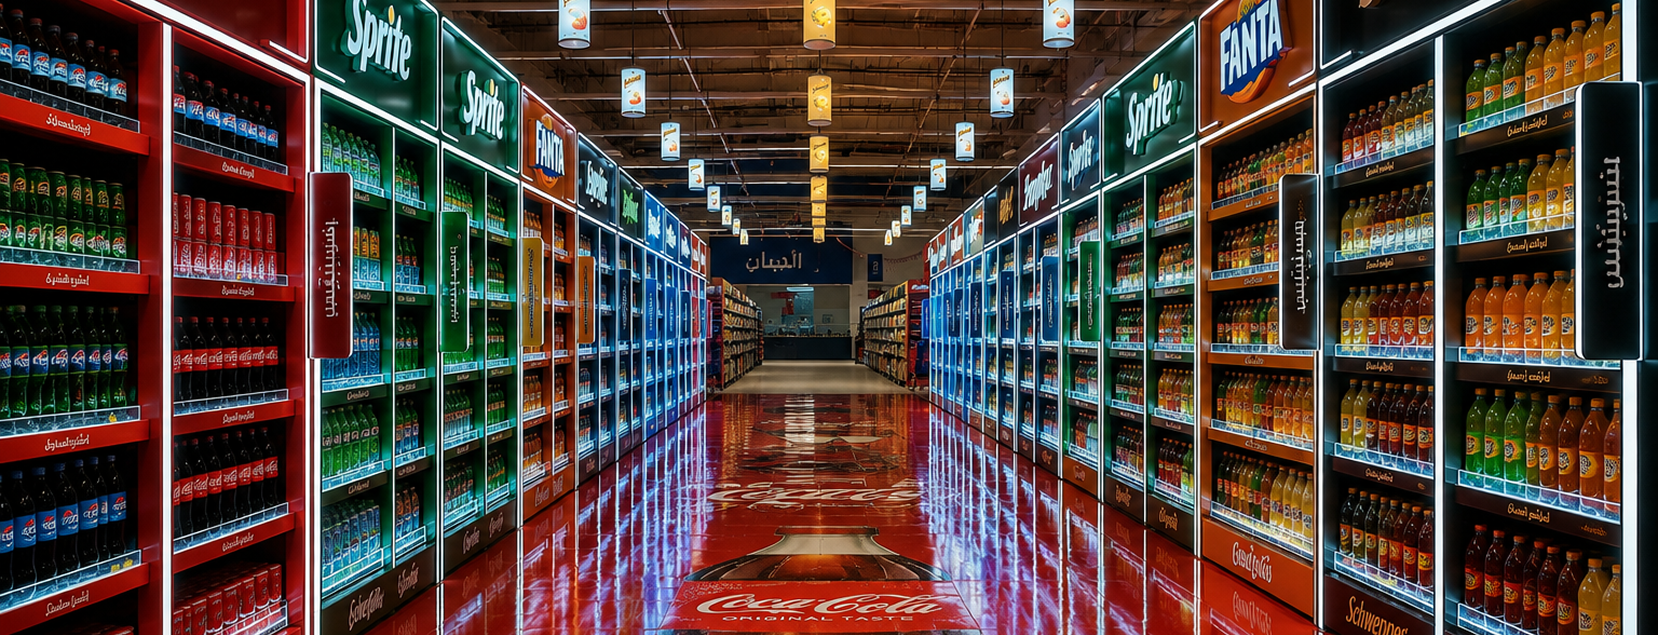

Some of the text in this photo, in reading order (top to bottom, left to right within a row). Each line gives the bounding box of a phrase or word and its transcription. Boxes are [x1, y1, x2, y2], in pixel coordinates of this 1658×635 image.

[347, 0, 412, 81] Sprite
[1220, 0, 1283, 93] FANTA
[463, 69, 505, 140] Sprite
[1125, 72, 1173, 155] Sprite
[535, 119, 566, 176] FANTA
